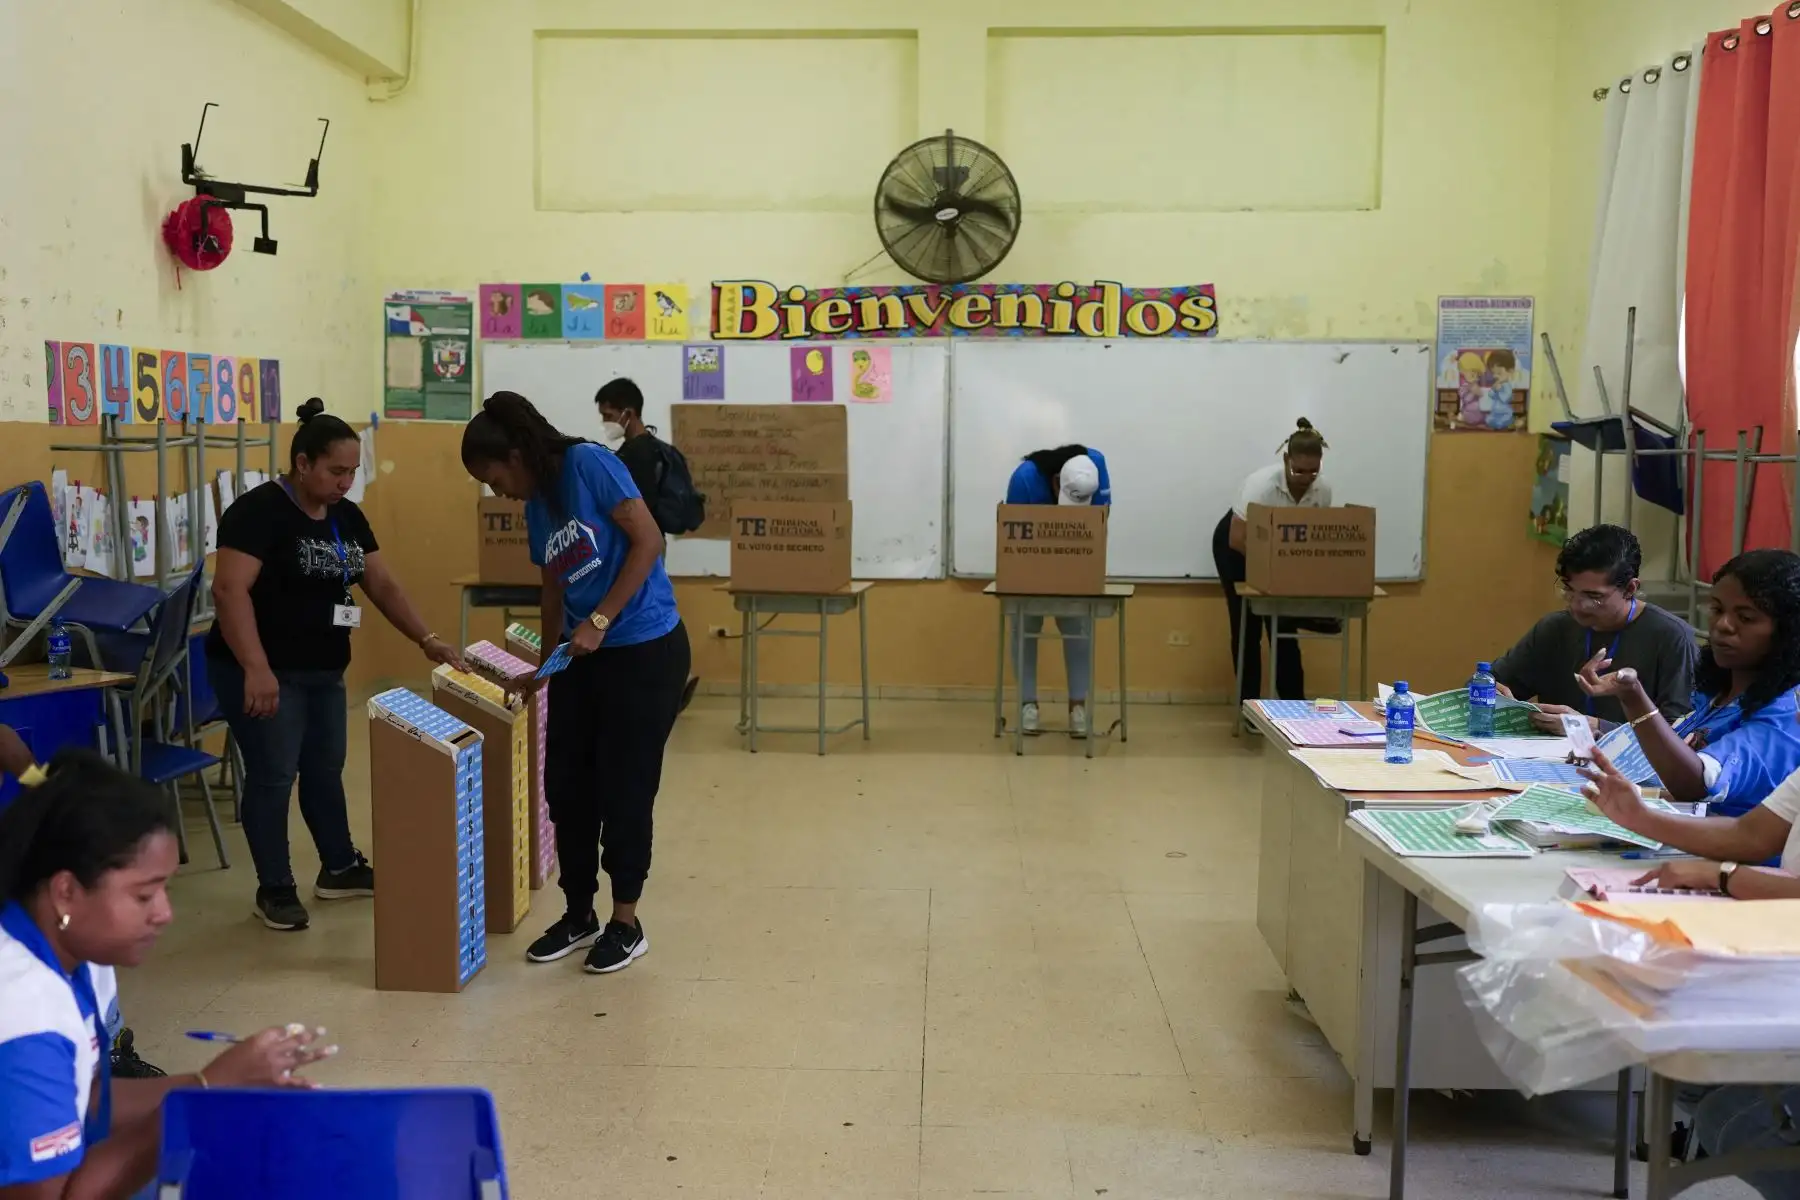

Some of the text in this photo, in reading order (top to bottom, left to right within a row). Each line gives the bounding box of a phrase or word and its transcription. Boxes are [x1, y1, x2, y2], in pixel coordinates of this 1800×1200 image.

[711, 280, 1218, 341] Bienvenidos
[68, 345, 94, 421] 3
[104, 346, 128, 421] 4
[137, 352, 159, 422] 5
[165, 355, 186, 422] 6
[191, 358, 212, 417] 7
[217, 358, 236, 422] 8
[239, 362, 255, 422] 9
[484, 512, 512, 531] TE
[771, 518, 818, 527] TRIBUNAL
[1038, 522, 1086, 530] TRIBUNAL
[736, 517, 767, 536] TE
[1003, 520, 1034, 540] TE
[1312, 524, 1361, 532] TRIBUNAL
[770, 527, 826, 537] ELECTORAL
[1037, 530, 1094, 539] ELECTORAL
[1277, 524, 1308, 542] TE
[1311, 532, 1367, 541] ELECTORAL
[749, 543, 772, 551] VOTO
[773, 543, 785, 551] ES
[786, 544, 824, 552] SECRETO
[1003, 546, 1094, 555] EL VOTO ES SECRETO
[1278, 549, 1366, 557] EL VOTO ES SECRETO
[568, 557, 602, 584] avanzamos
